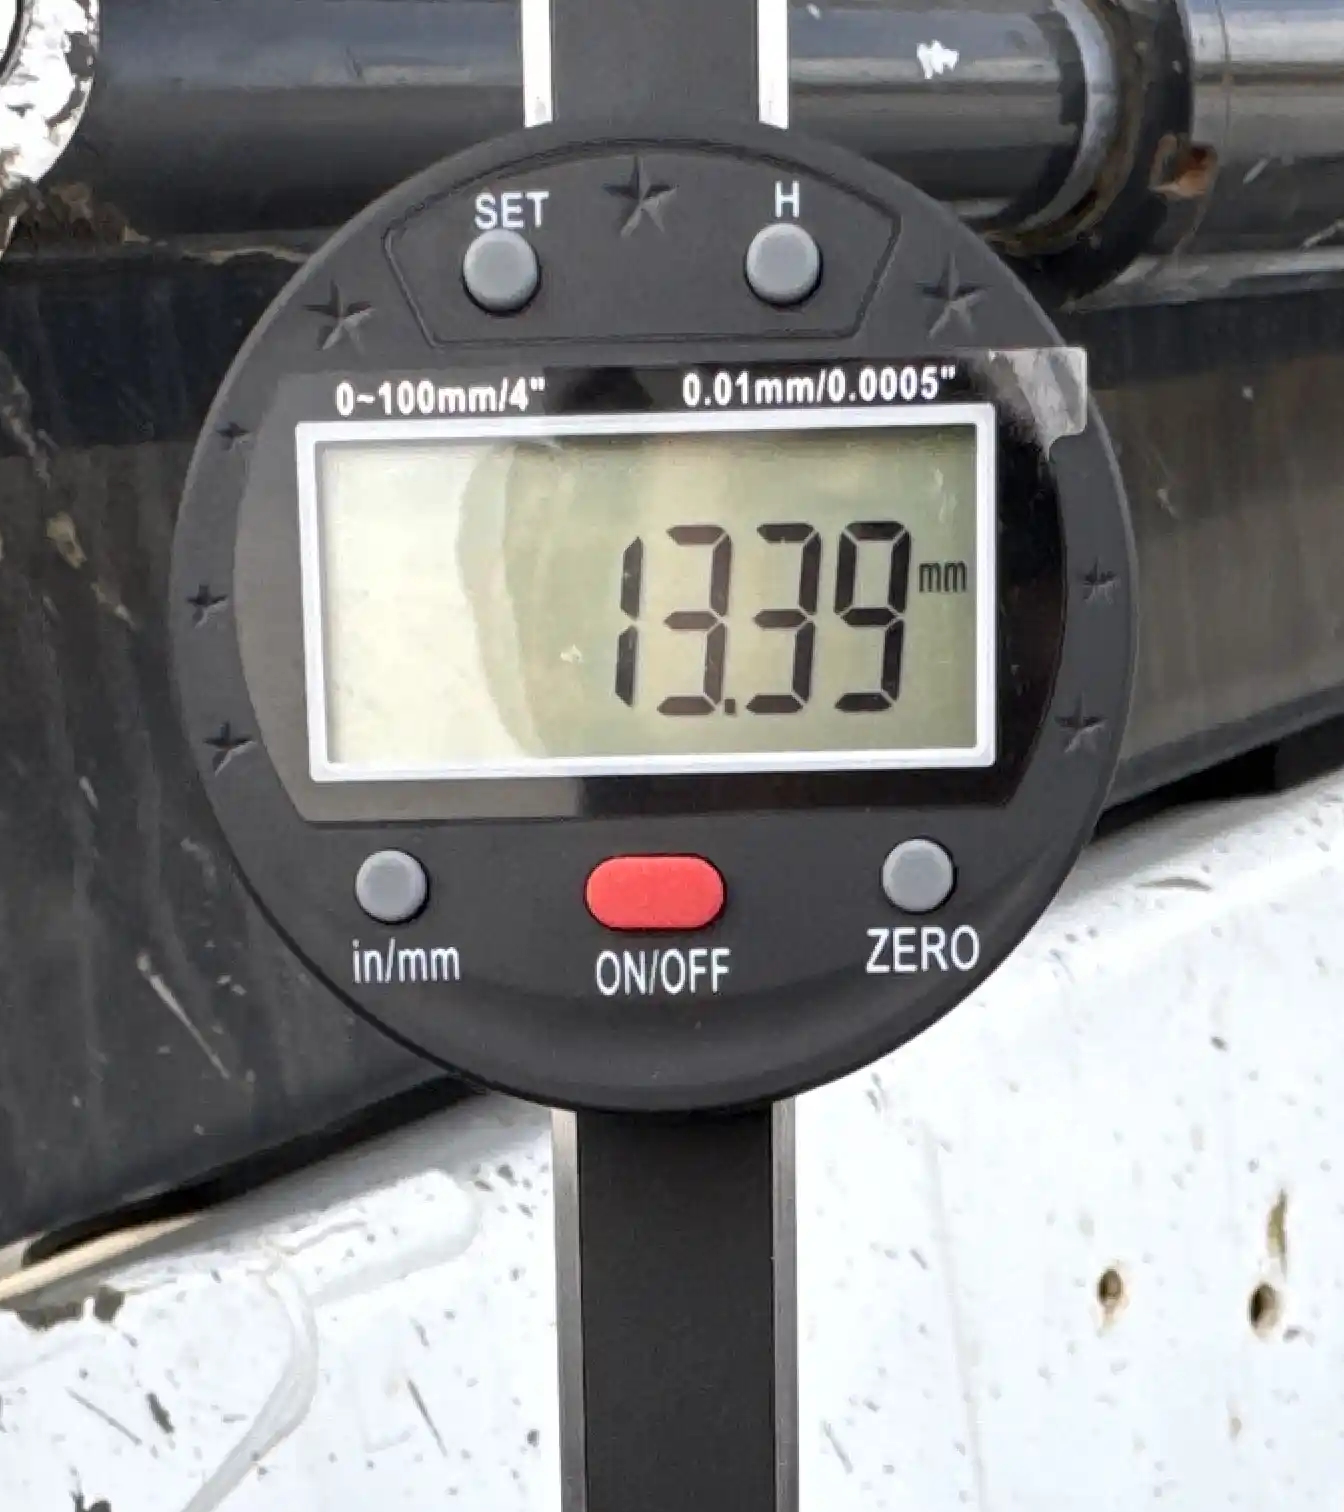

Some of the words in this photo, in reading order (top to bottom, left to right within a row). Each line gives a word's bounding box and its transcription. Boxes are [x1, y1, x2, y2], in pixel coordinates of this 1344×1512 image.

[474, 191, 550, 229] SET
[774, 181, 800, 219] H
[681, 364, 958, 407] 0.01mm/0.0005"
[613, 519, 913, 717] 13.39
[918, 559, 969, 594] mm
[352, 938, 461, 984] in/mm
[594, 948, 732, 996] ON/OFF
[865, 924, 982, 974] ZERO
